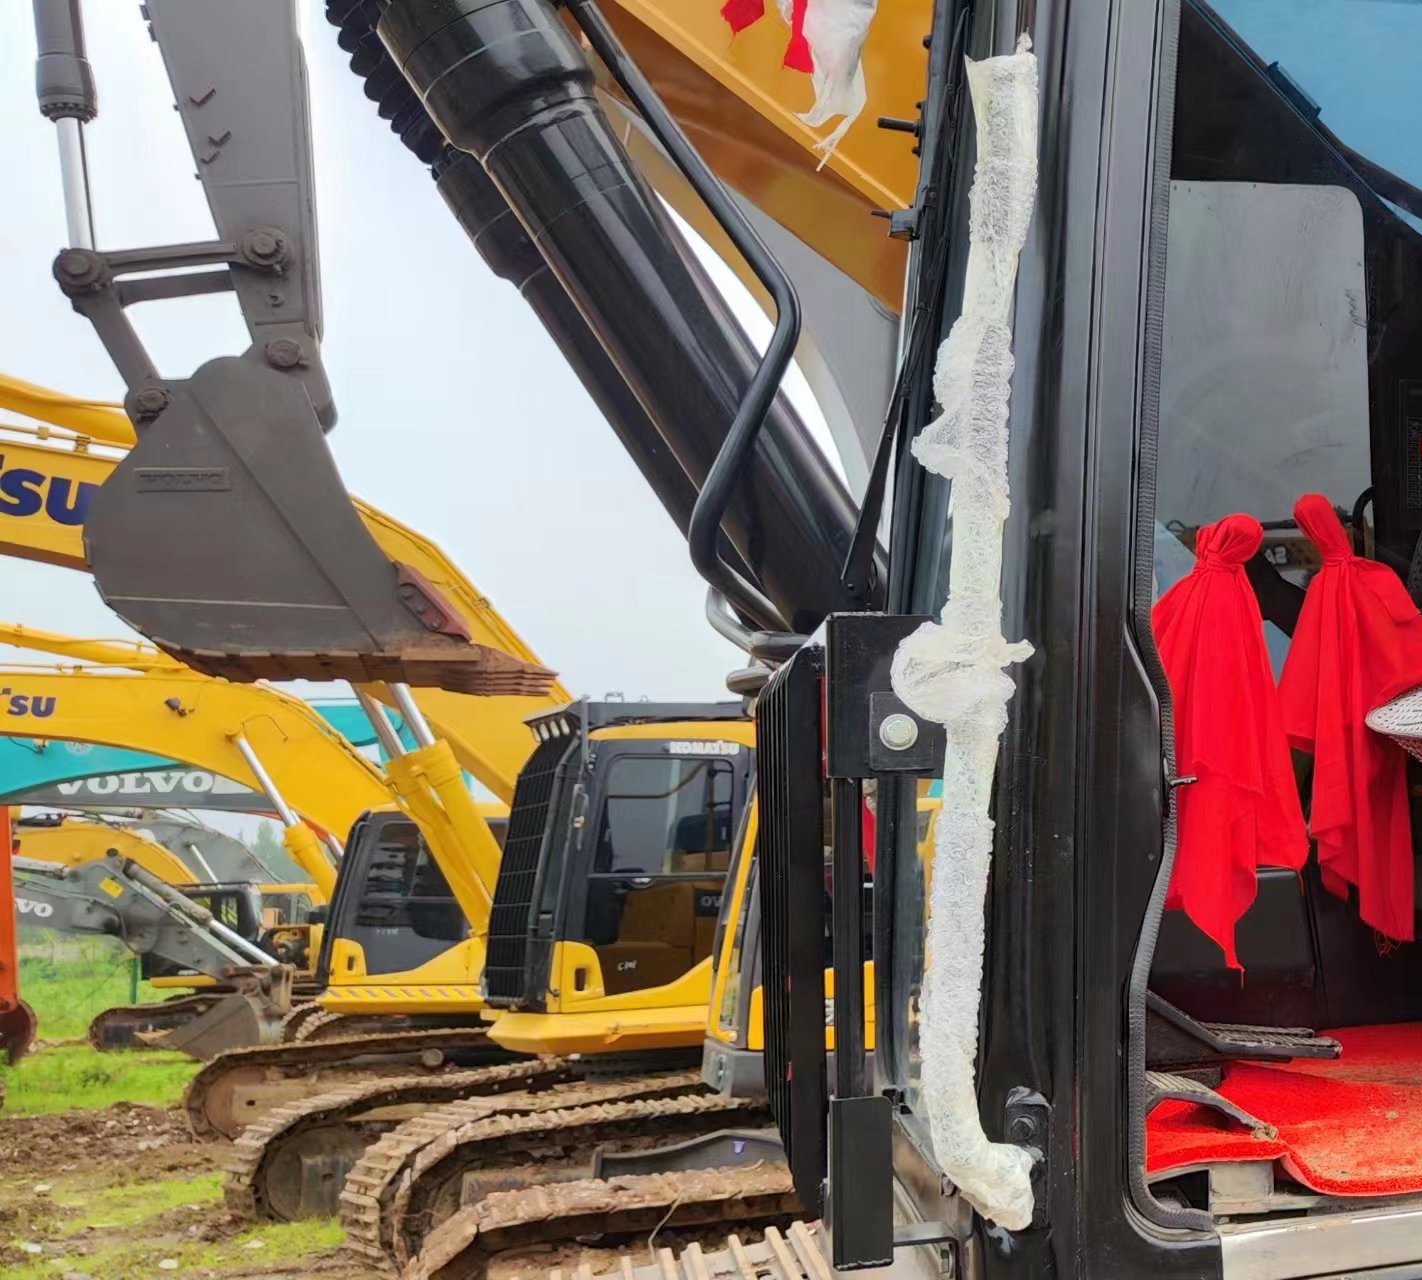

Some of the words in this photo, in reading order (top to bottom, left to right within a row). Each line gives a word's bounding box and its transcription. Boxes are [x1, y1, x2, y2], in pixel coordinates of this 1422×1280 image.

[0, 454, 101, 525] SU
[670, 741, 739, 755] KOMATSU
[57, 771, 214, 795] VOLVO
